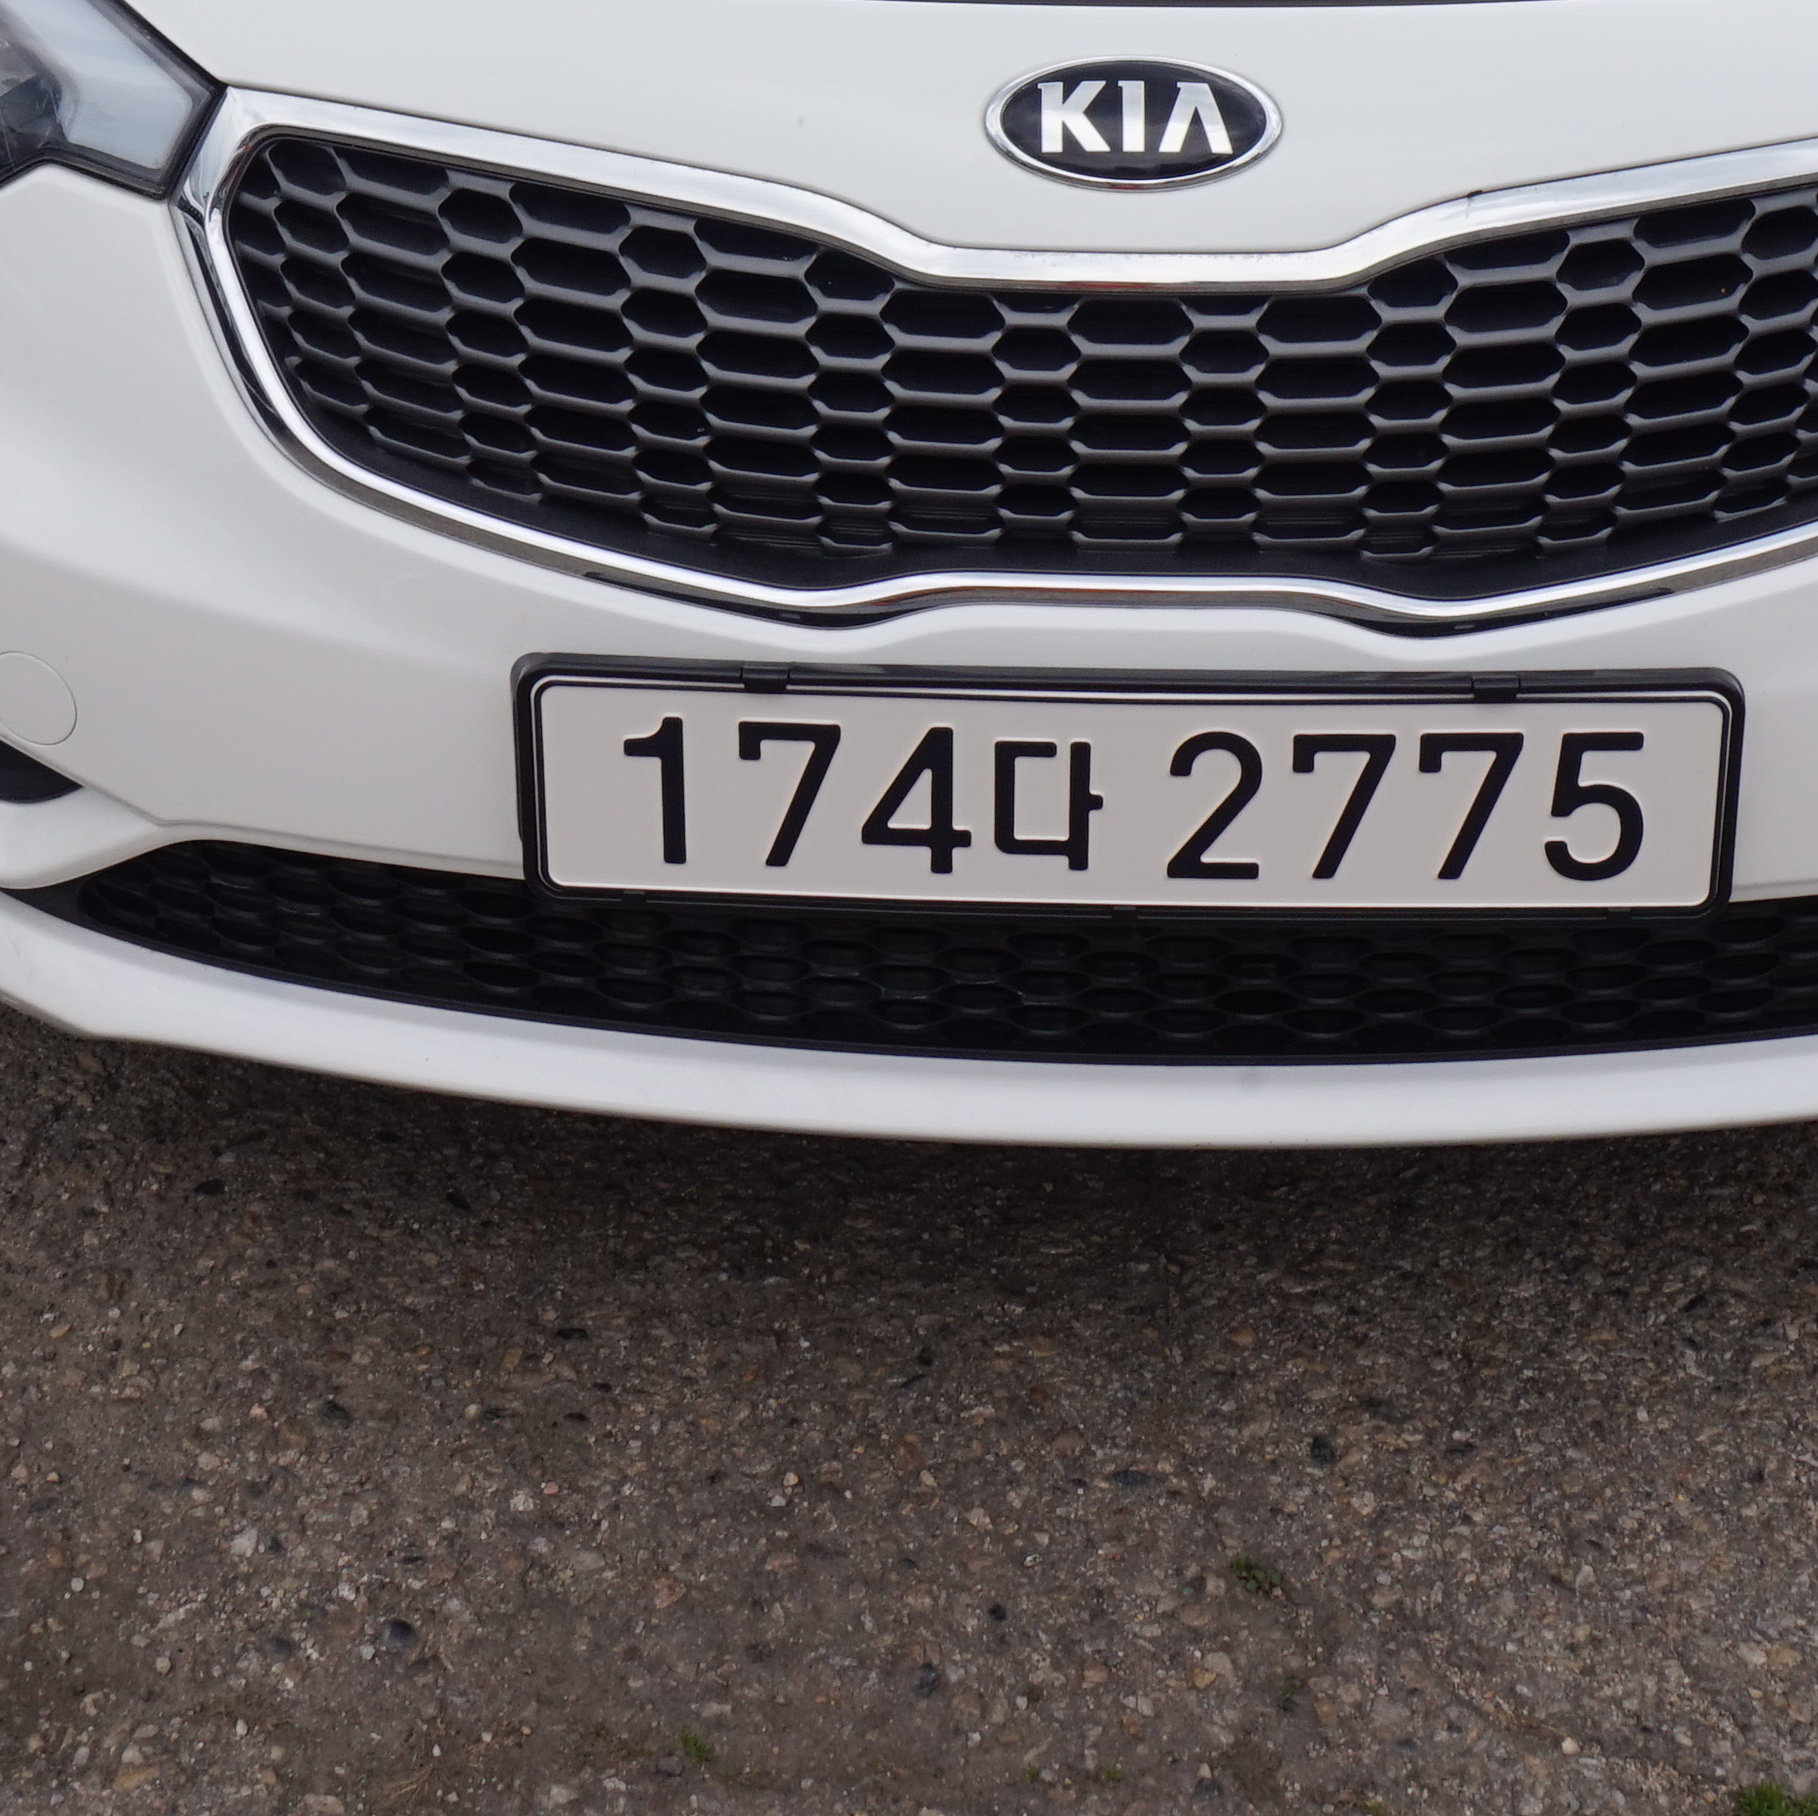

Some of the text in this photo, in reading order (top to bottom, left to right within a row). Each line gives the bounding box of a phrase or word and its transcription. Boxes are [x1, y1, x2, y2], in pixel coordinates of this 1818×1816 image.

[1036, 79, 1235, 155] KIA
[622, 715, 1646, 881] 174다 2775
